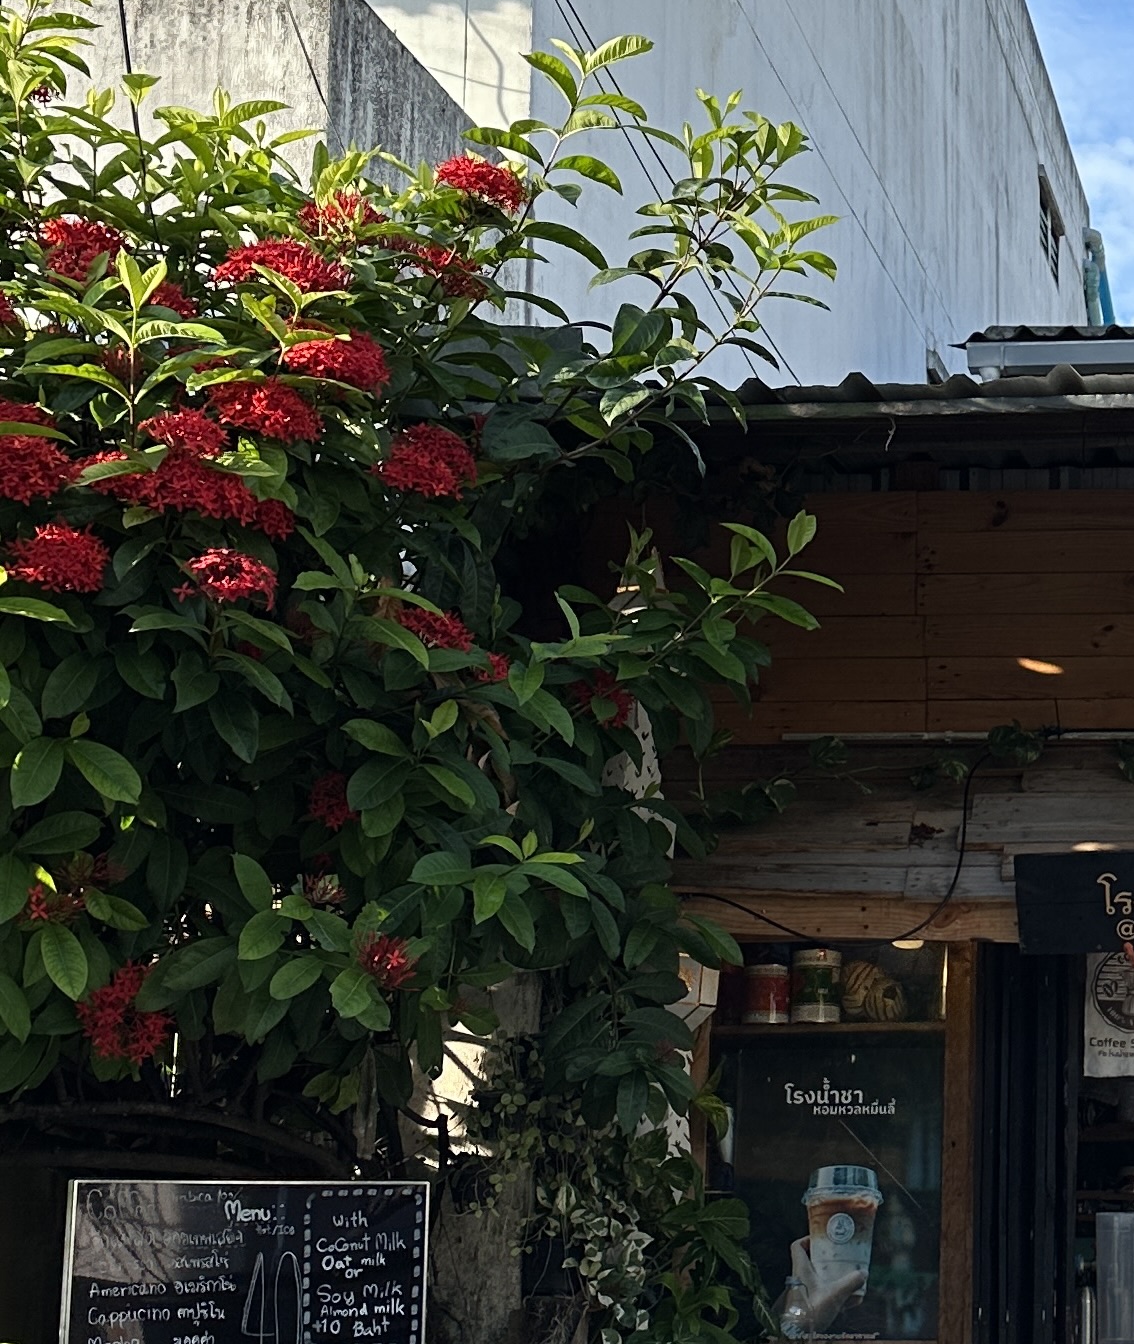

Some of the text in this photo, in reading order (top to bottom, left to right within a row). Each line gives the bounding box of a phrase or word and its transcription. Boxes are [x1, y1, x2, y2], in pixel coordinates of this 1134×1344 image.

[1090, 1037, 1127, 1048] Coffee
[784, 1076, 864, 1105] โรงน้ำชา
[375, 1231, 407, 1251] Milk
[321, 1252, 386, 1271] Oat milk
[344, 1268, 364, 1279] or
[89, 1282, 167, 1298] Americano
[316, 1284, 355, 1307] Soy
[320, 1297, 406, 1317] Almond milk
[88, 1306, 170, 1329] Cappucino
[352, 1316, 390, 1337] Baht
